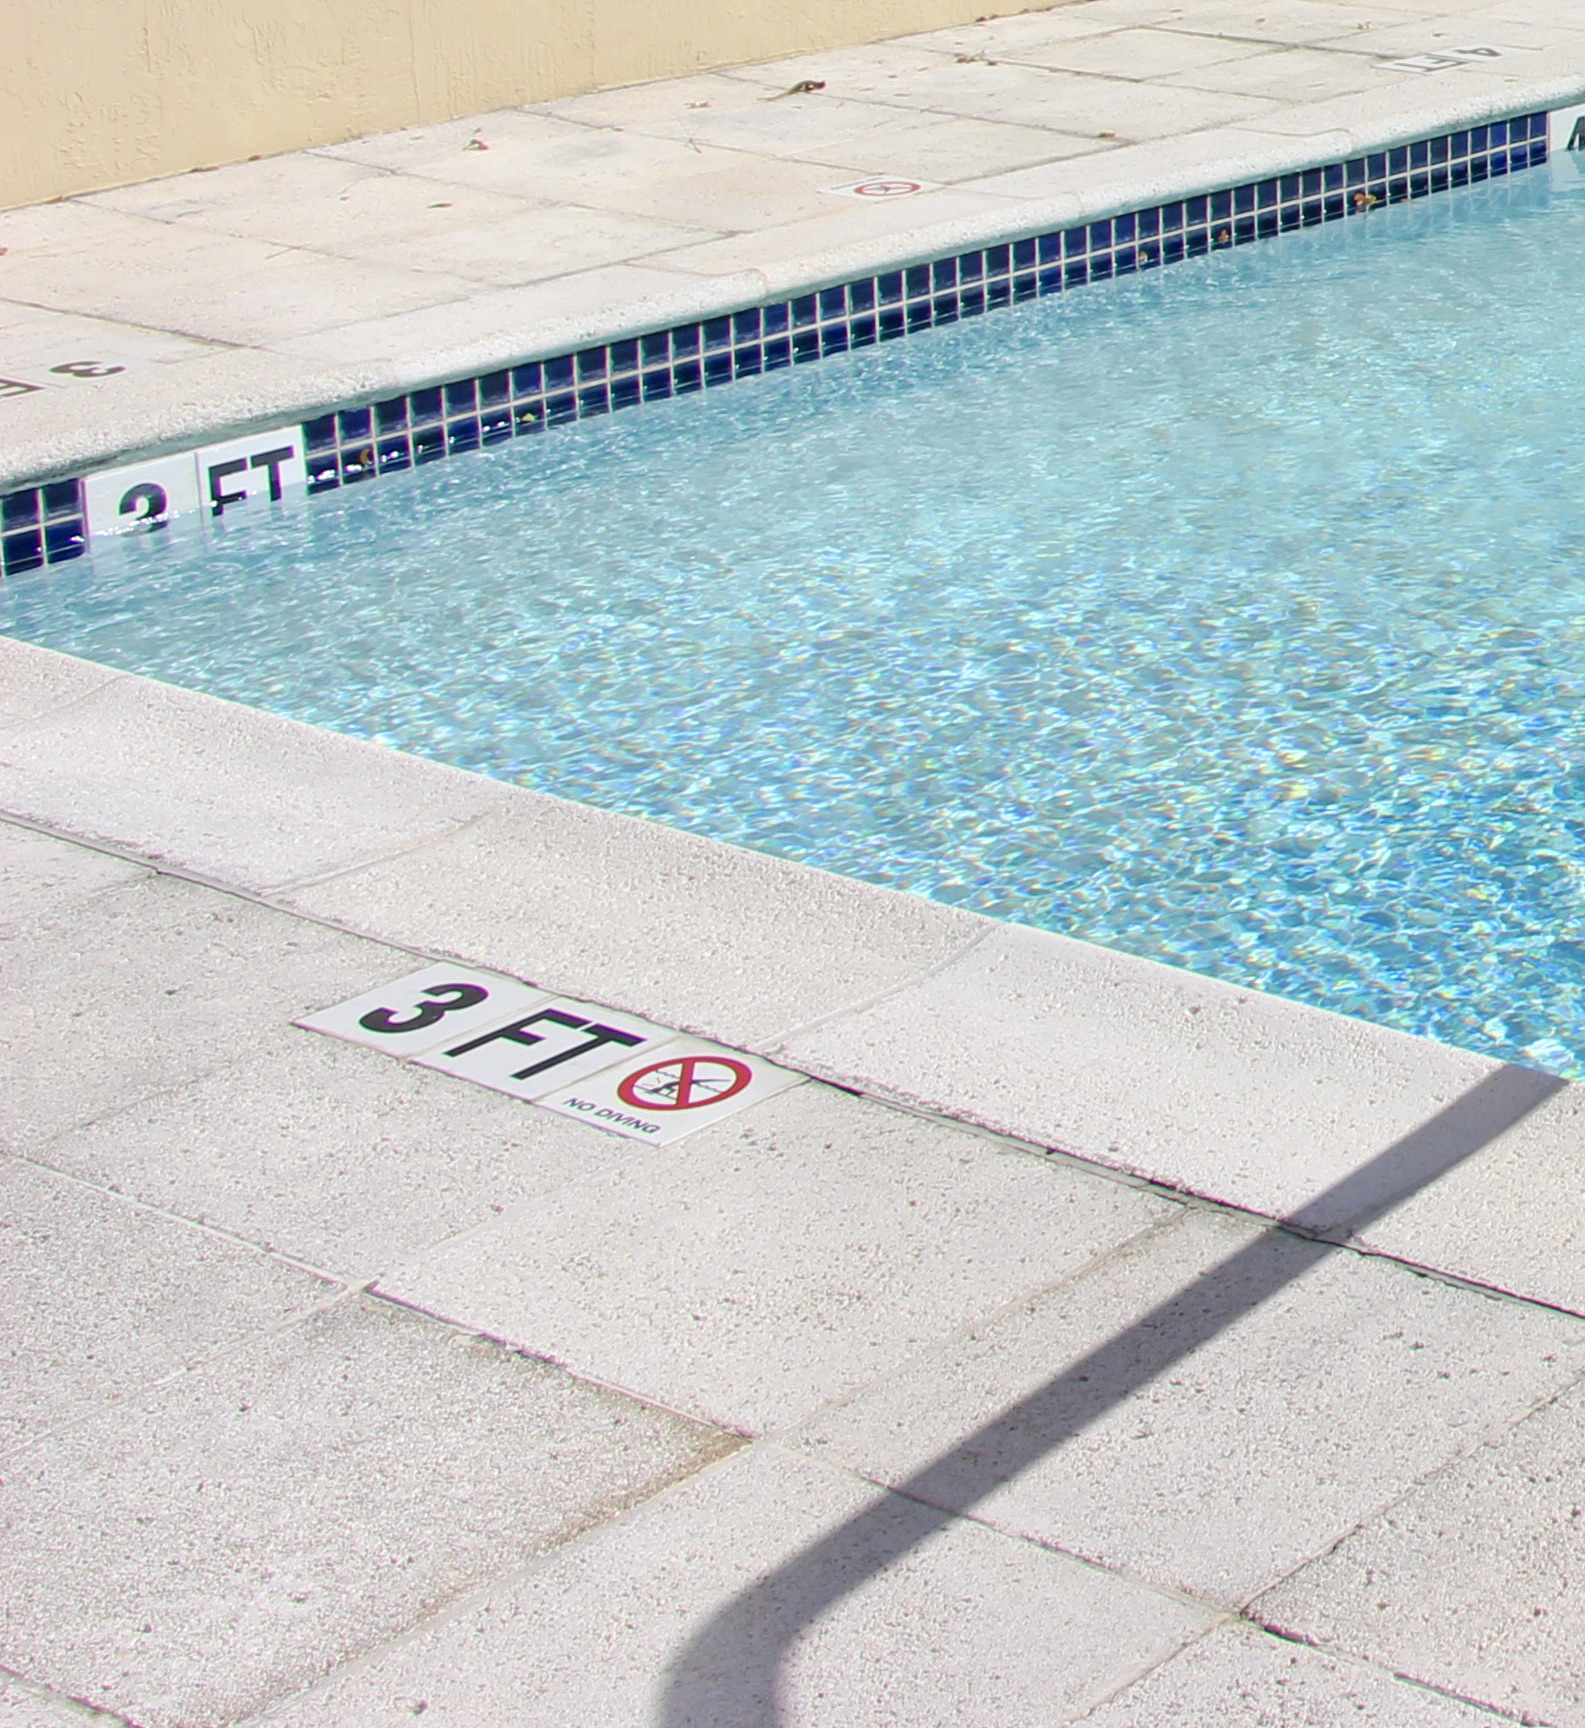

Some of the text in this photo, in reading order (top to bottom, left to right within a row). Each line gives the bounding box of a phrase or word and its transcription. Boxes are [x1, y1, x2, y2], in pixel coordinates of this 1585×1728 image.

[207, 445, 295, 517] FT
[358, 983, 648, 1080] 3 FT
[563, 1097, 662, 1134] NO DIVING
